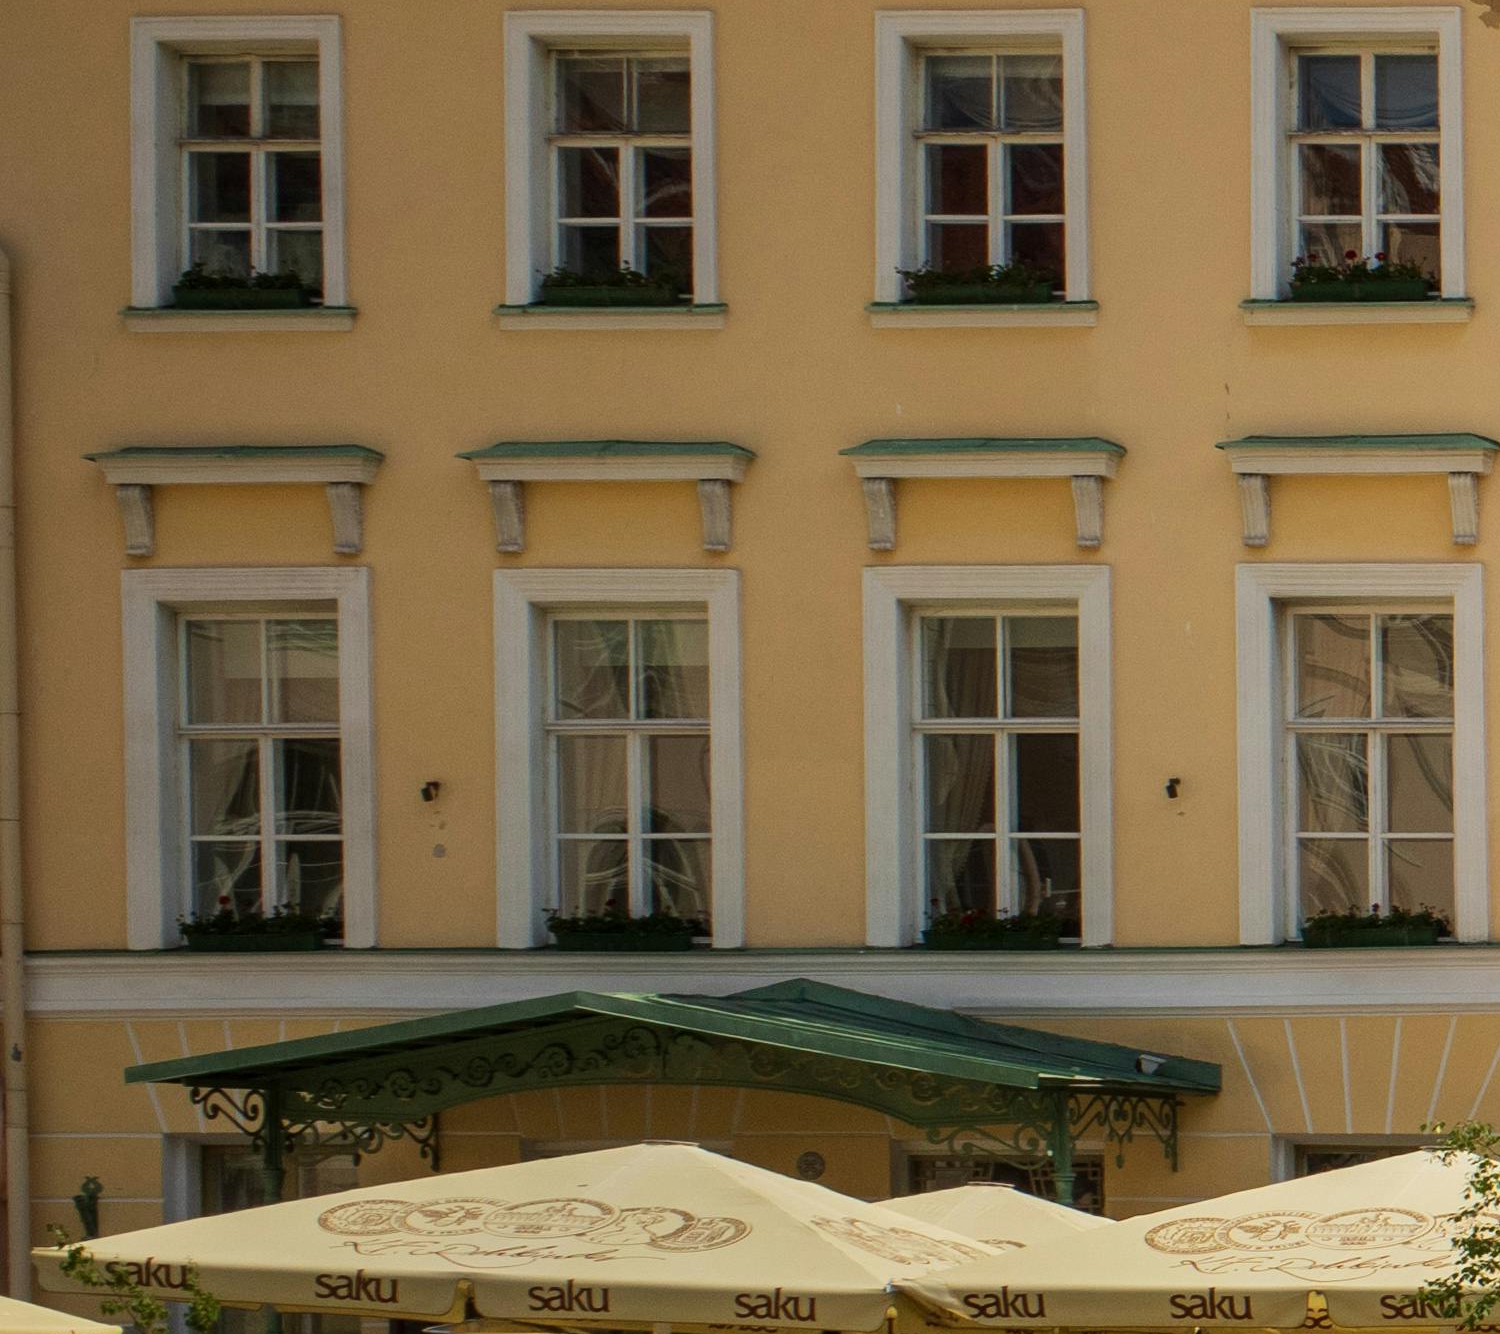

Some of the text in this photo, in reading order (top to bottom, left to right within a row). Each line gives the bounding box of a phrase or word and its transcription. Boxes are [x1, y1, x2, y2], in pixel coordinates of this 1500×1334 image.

[105, 1257, 188, 1288] saku
[315, 1269, 398, 1302] saku
[528, 1279, 610, 1312] saku
[735, 1288, 816, 1321] saku
[963, 1286, 1046, 1319] saku
[1170, 1287, 1253, 1320] saku
